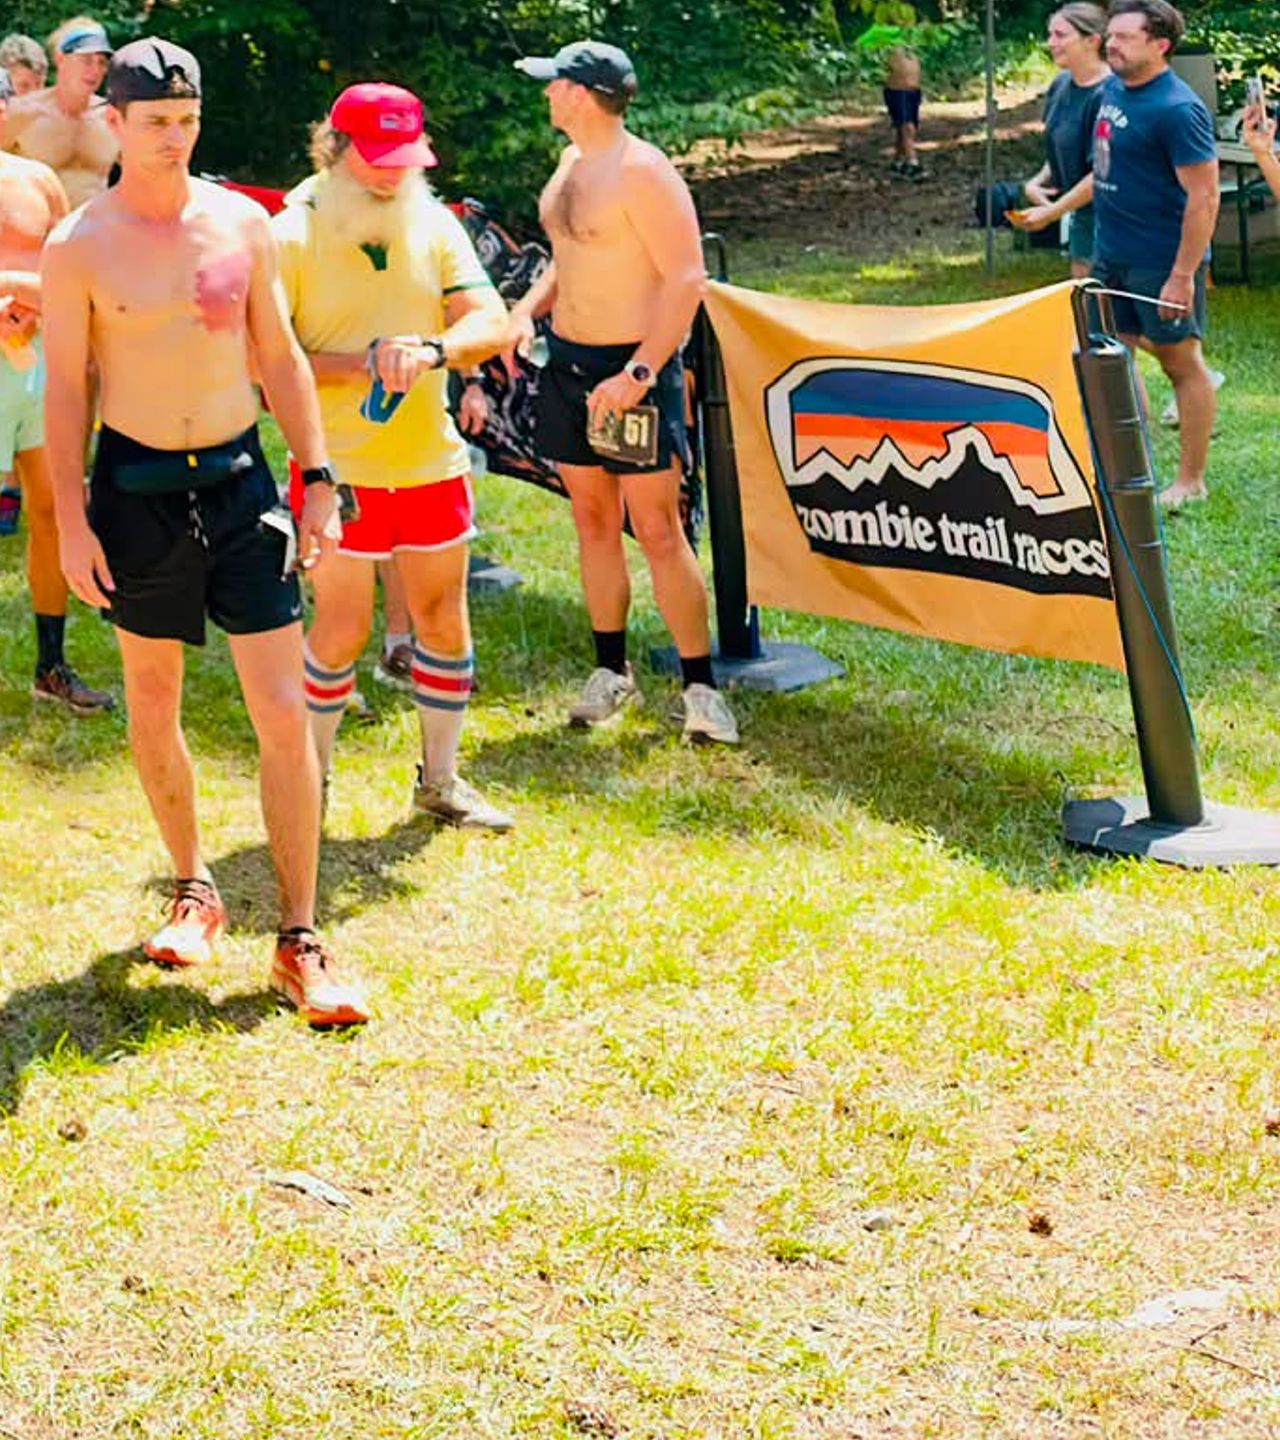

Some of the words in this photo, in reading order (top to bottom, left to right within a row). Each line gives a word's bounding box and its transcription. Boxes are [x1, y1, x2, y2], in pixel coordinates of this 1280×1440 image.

[796, 501, 938, 552] zombie
[939, 513, 1013, 565] trail
[1014, 533, 1110, 579] races
